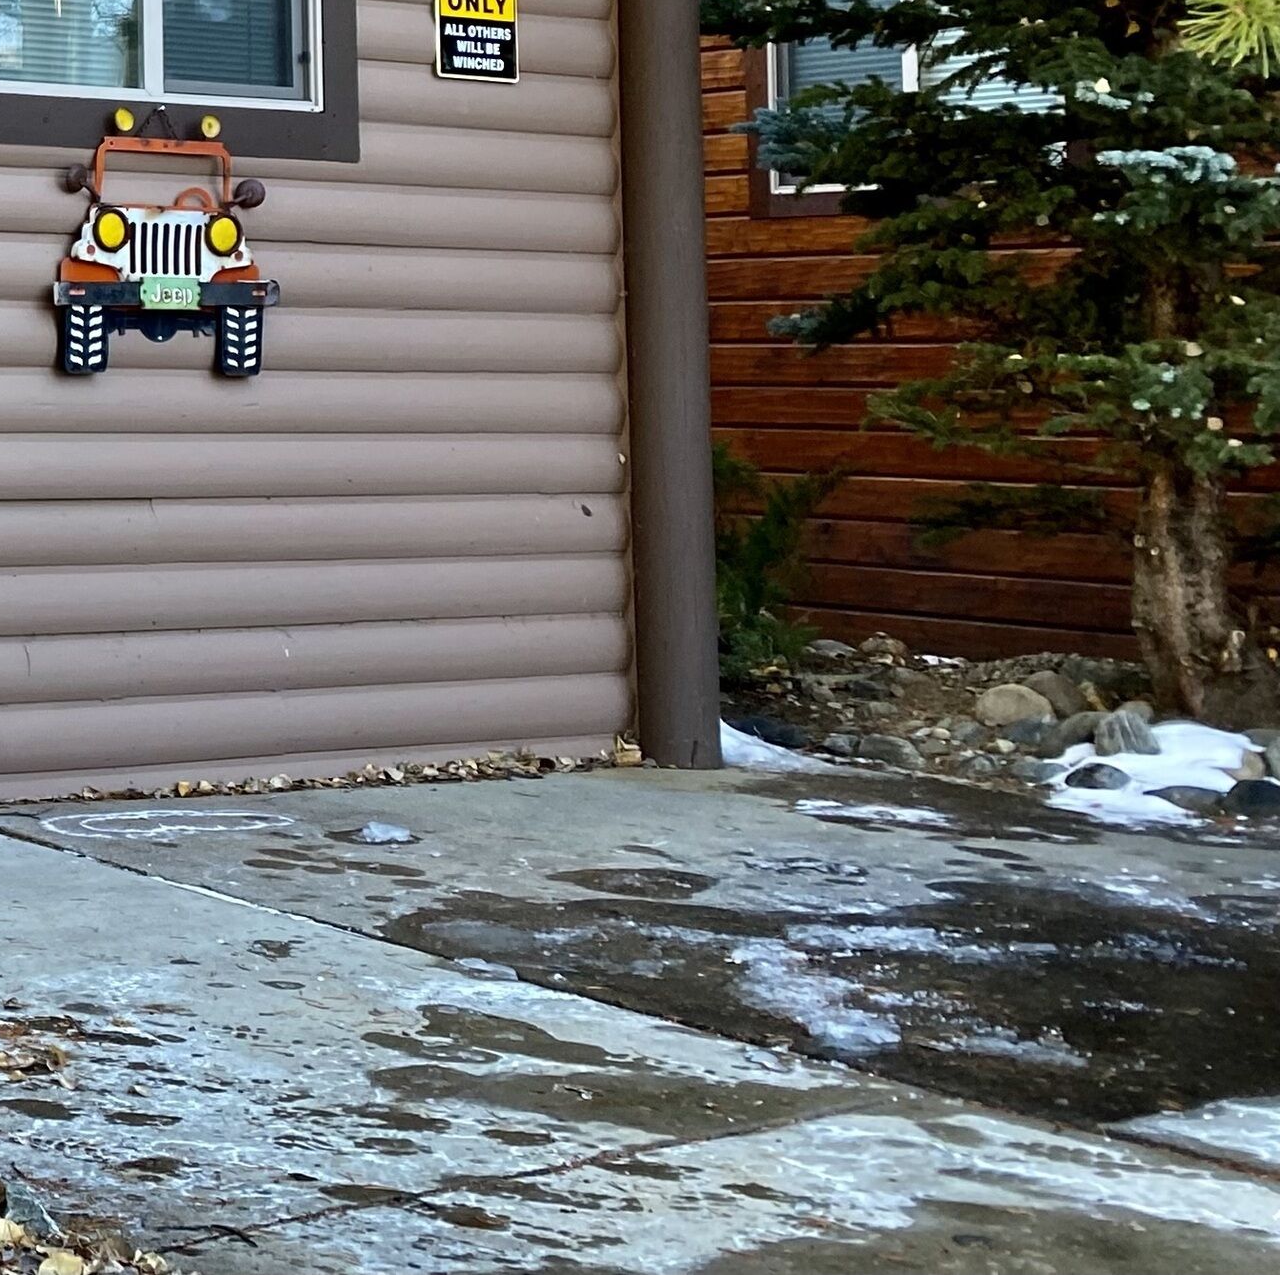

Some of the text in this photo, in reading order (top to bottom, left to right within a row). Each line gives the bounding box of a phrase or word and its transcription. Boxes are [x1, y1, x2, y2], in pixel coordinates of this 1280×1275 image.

[444, 23, 511, 41] ALL OTHERS
[456, 39, 501, 55] WILL BE
[452, 55, 505, 71] WINCHED
[150, 283, 193, 307] Jeep
